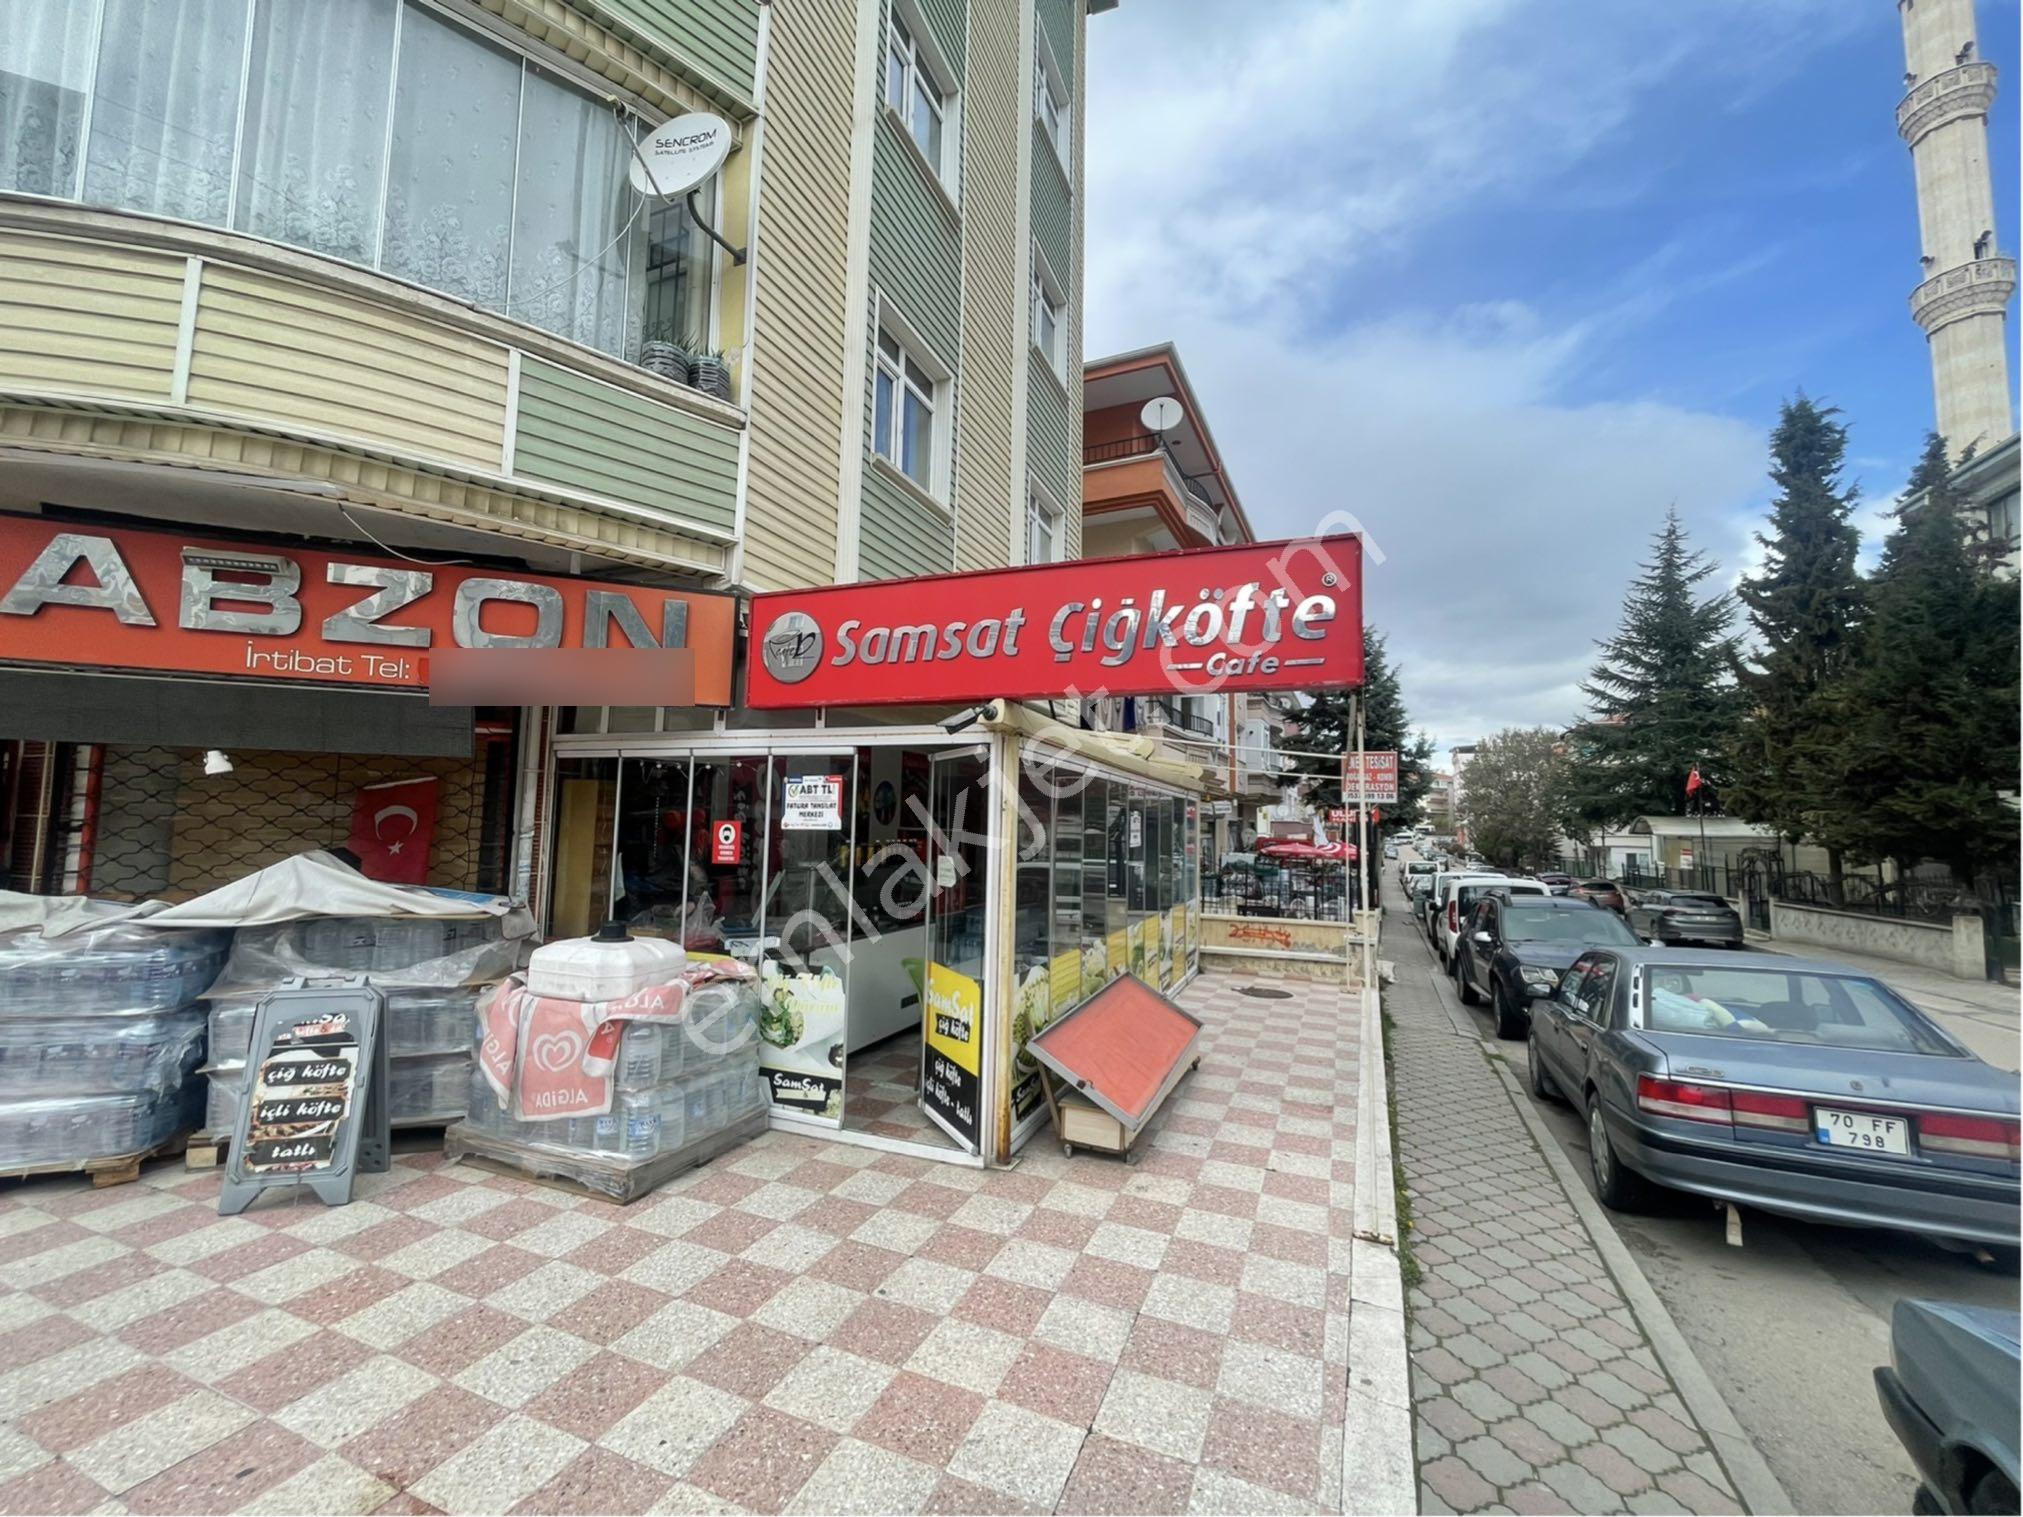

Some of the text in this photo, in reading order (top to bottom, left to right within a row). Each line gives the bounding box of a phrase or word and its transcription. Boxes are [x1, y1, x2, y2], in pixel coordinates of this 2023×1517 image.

[655, 129, 717, 148] SENCROM
[831, 607, 1026, 666] Samsat
[245, 640, 411, 679] İrtibat Tel:
[1206, 651, 1279, 676] Cafe
[800, 784, 820, 795] ABT
[301, 1063, 347, 1079] köfte
[772, 1072, 826, 1093] SamSat
[296, 1101, 342, 1117] köfte
[1830, 1113, 1896, 1134] 70 FF
[1848, 1132, 1885, 1149] 798
